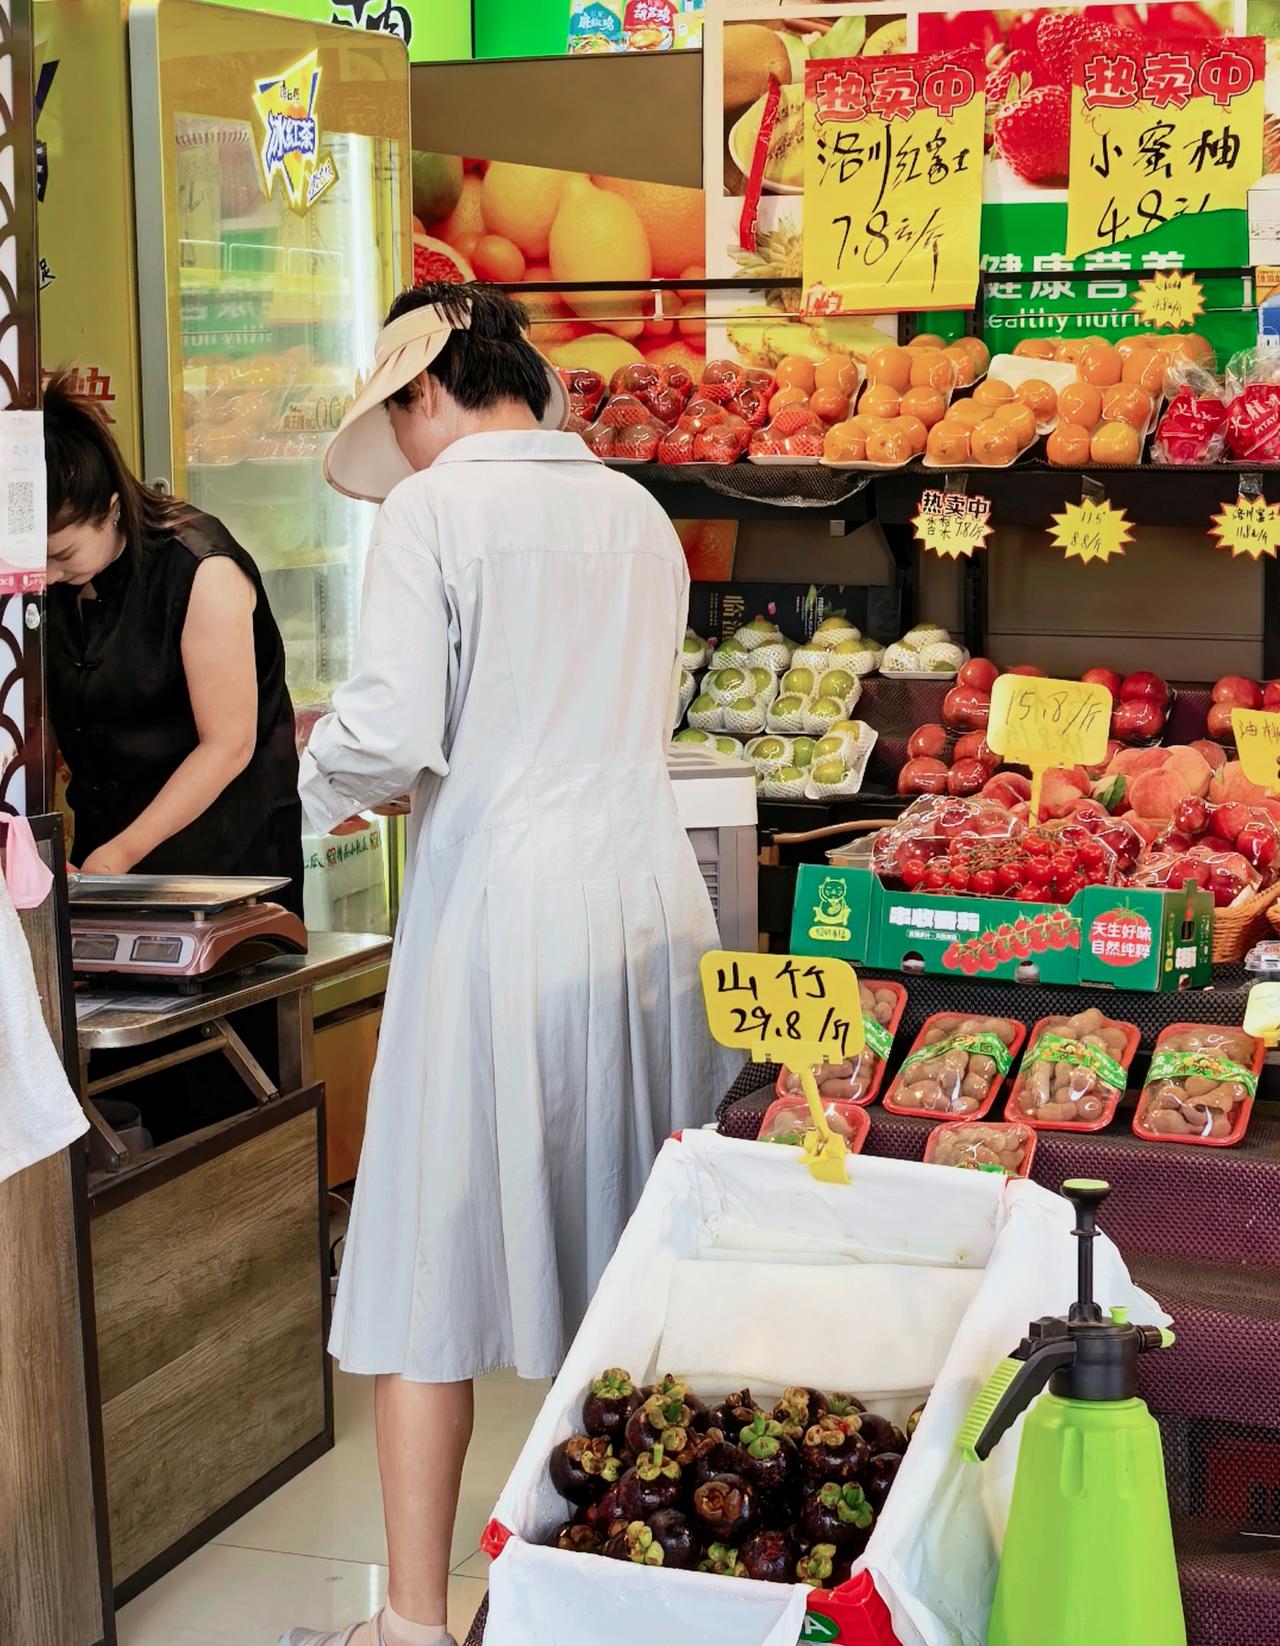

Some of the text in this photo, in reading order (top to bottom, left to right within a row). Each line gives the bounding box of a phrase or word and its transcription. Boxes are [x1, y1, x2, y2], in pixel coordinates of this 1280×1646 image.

[815, 64, 975, 125] 热卖中
[1084, 52, 1254, 109] 热卖中
[816, 124, 971, 214] 洛川红富士
[1090, 121, 1240, 179] 小蜜柚
[922, 491, 988, 519] 热卖中
[1005, 690, 1102, 736] 15.8/斤
[1091, 921, 1152, 941] 天生好味
[717, 960, 826, 1001] 山竹
